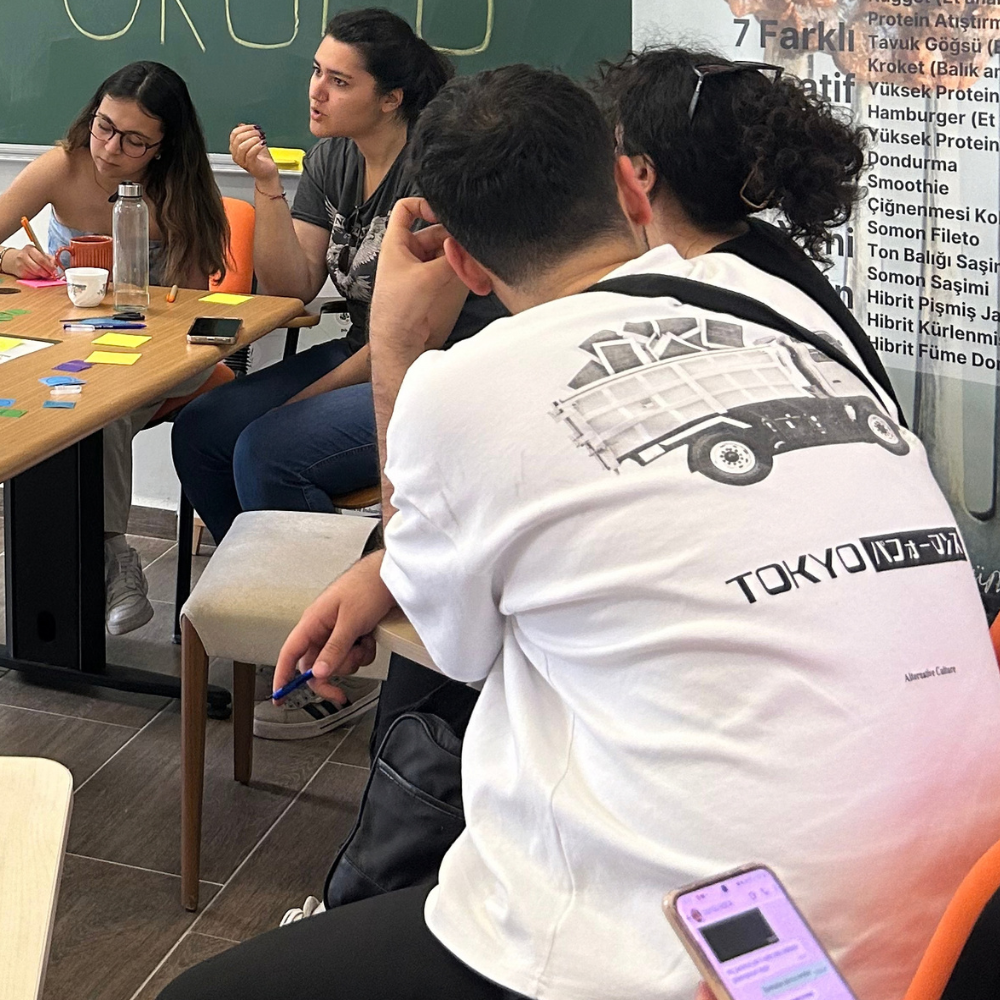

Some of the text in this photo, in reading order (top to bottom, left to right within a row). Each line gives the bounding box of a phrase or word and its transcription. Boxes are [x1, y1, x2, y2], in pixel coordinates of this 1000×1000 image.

[868, 12, 930, 28] Protein
[733, 18, 854, 52] 7 Farklı
[868, 35, 920, 51] Tavuk
[925, 37, 982, 56] Göğsü
[868, 58, 925, 75] Kroket
[930, 60, 979, 78] (Balık
[868, 81, 1000, 103] Yüksek Protein
[868, 104, 996, 129] Hamburger (Et
[868, 128, 1000, 152] Yüksek Protein
[868, 151, 957, 172] Dondurma
[867, 174, 949, 195] Smoothie
[868, 197, 1000, 225] Çiğnenmesi Ko
[867, 220, 980, 247] Somon Fileto
[867, 243, 899, 260] Ton
[904, 247, 951, 270] Balığı
[867, 266, 989, 296] Somon Saşimi
[867, 289, 914, 309] Hibrit
[919, 296, 976, 322] Pişmiş
[867, 312, 1000, 347] Hibrit Kürlenmi
[867, 335, 914, 356] Hibrit
[919, 343, 967, 365] Füme
[725, 543, 867, 604] TOKYO
